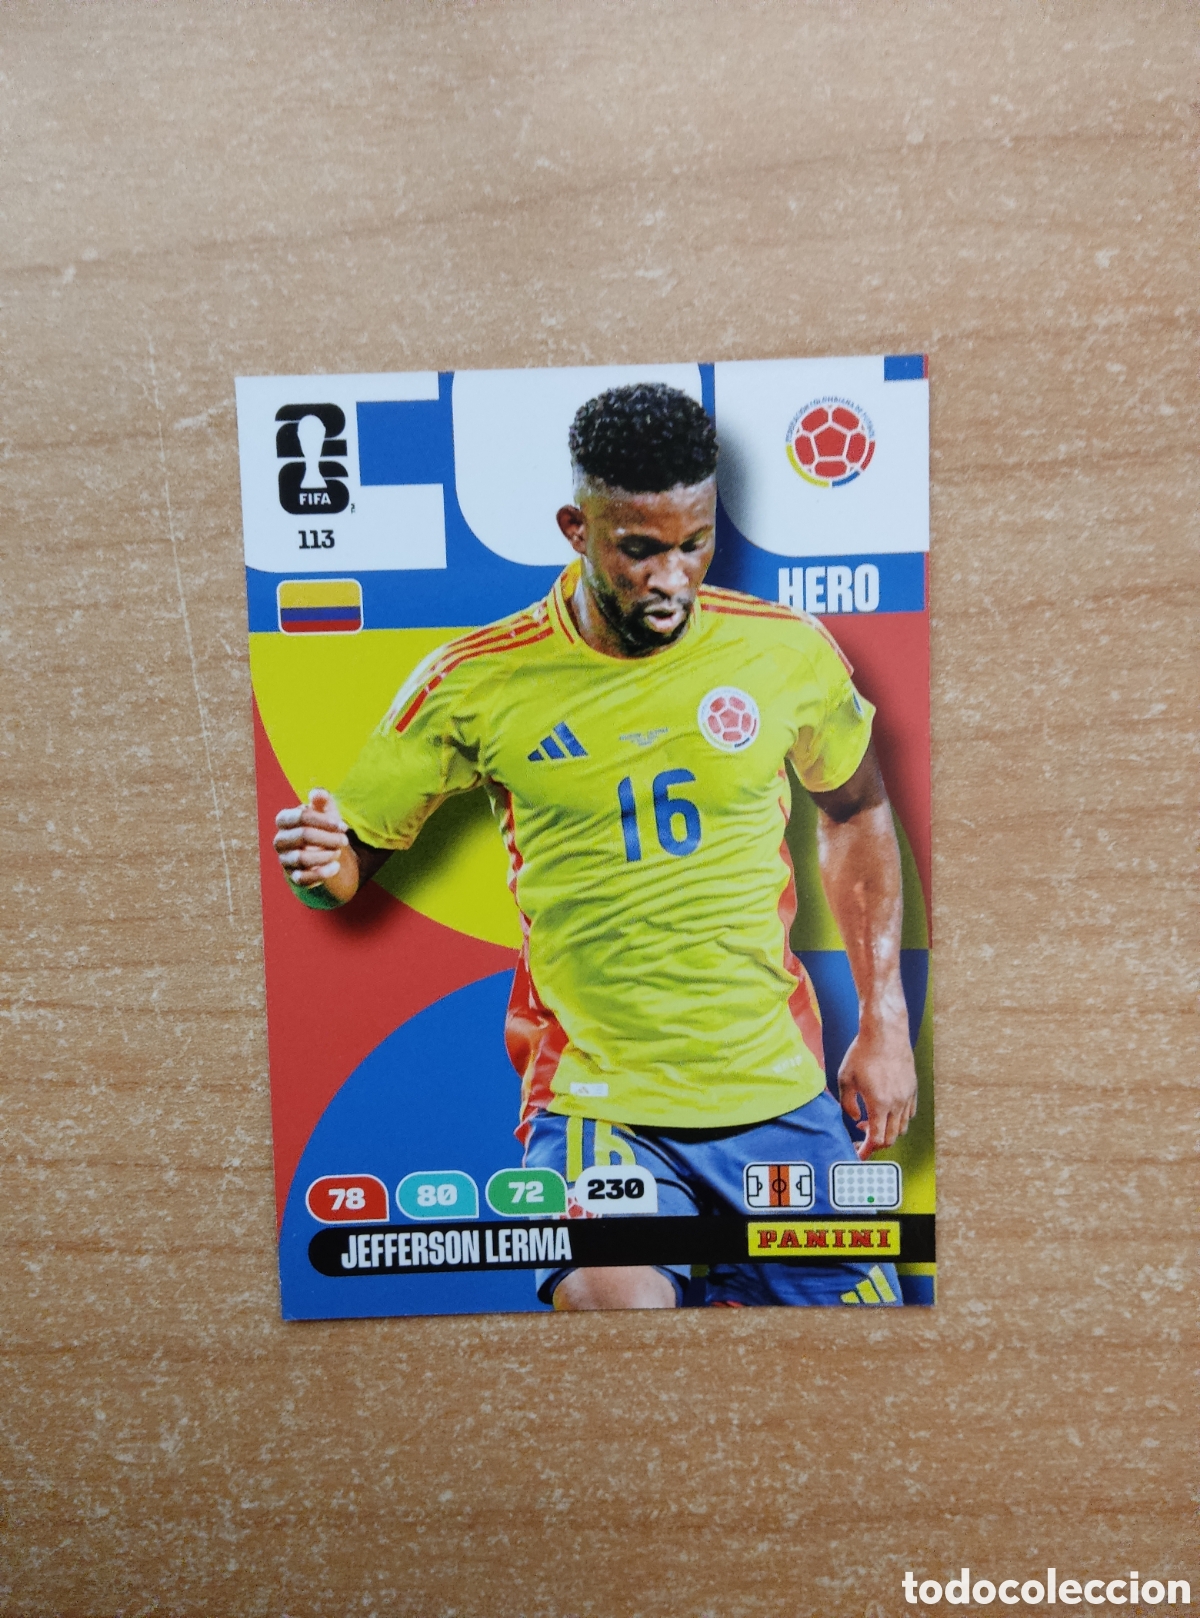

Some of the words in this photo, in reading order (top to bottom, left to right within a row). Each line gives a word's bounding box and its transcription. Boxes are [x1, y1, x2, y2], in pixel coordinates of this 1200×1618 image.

[299, 491, 332, 506] FIFA
[298, 529, 335, 549] 113
[778, 563, 880, 614] HERO
[617, 768, 702, 862] 16
[328, 1187, 366, 1210] 78
[416, 1184, 458, 1207] 80
[508, 1181, 545, 1204] 72
[587, 1178, 645, 1200] 230
[341, 1229, 480, 1270] JEFFERSON
[485, 1227, 573, 1264] LERMA
[757, 1229, 891, 1248] PANINI
